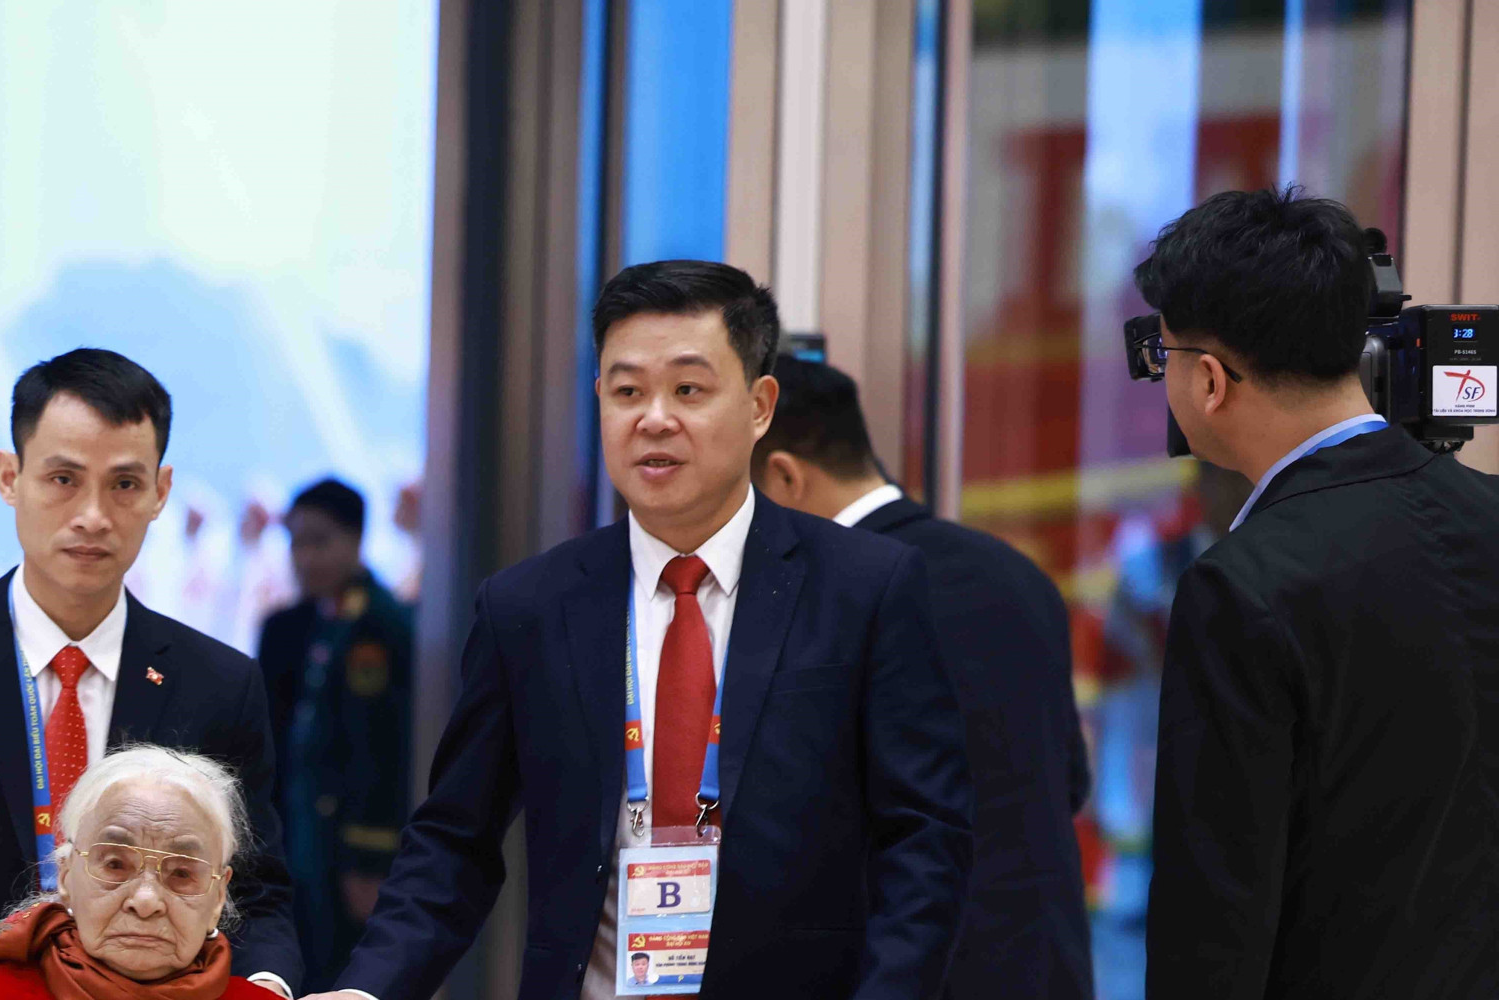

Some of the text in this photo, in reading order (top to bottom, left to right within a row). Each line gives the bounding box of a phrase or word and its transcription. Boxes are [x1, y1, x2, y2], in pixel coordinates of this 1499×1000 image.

[26, 683, 36, 704] QUỐC
[29, 705, 39, 726] TOÀN
[31, 727, 41, 745] BIỂU
[33, 746, 42, 759] ĐẠI
[35, 760, 43, 774] HỘI
[36, 775, 45, 789] ĐẠI
[657, 881, 681, 908] B
